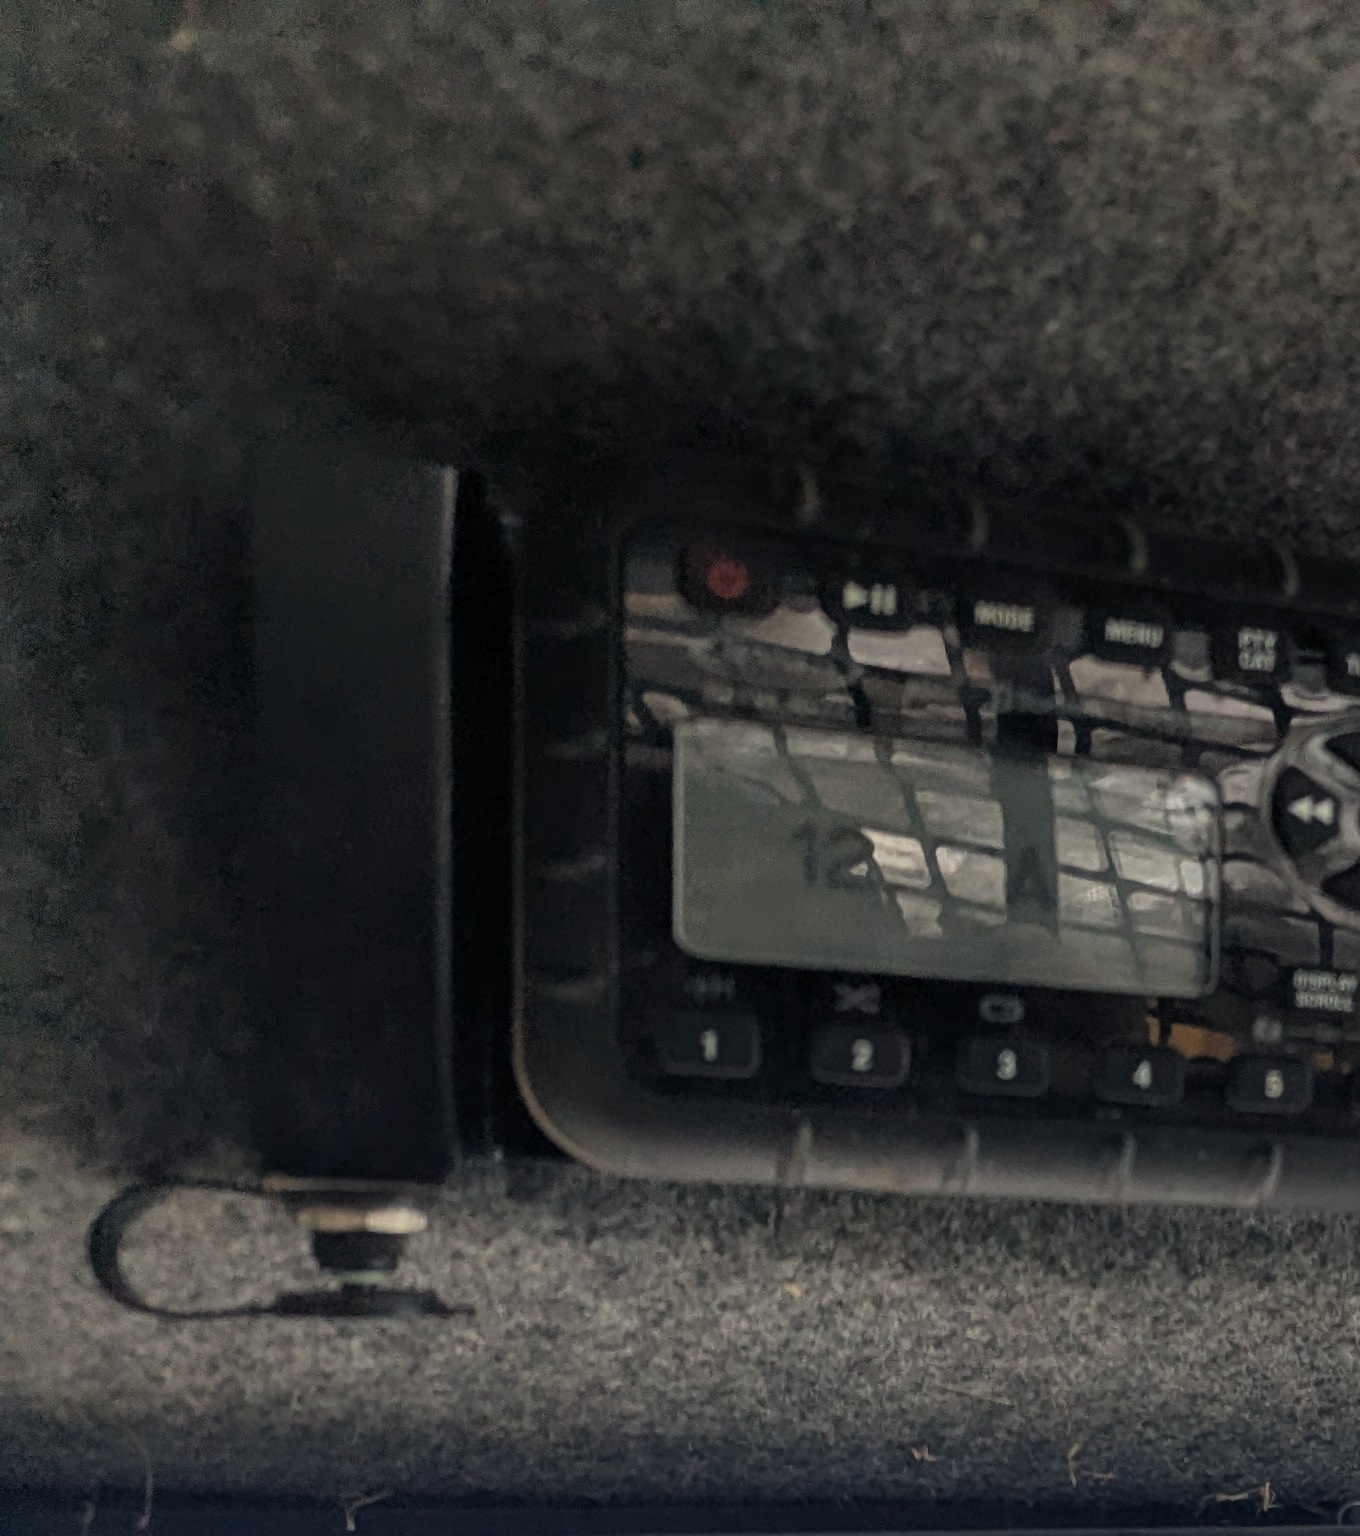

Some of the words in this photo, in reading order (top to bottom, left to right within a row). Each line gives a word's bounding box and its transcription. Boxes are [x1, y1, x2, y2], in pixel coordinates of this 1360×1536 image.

[1104, 617, 1164, 648] MENU
[1293, 967, 1360, 993] DISPLAY
[1295, 990, 1353, 1012] SCROLL
[701, 1028, 718, 1062] 1
[851, 1038, 874, 1071] 2
[996, 1048, 1017, 1080] 3
[1132, 1059, 1154, 1090] 4
[1264, 1068, 1285, 1099] 5
